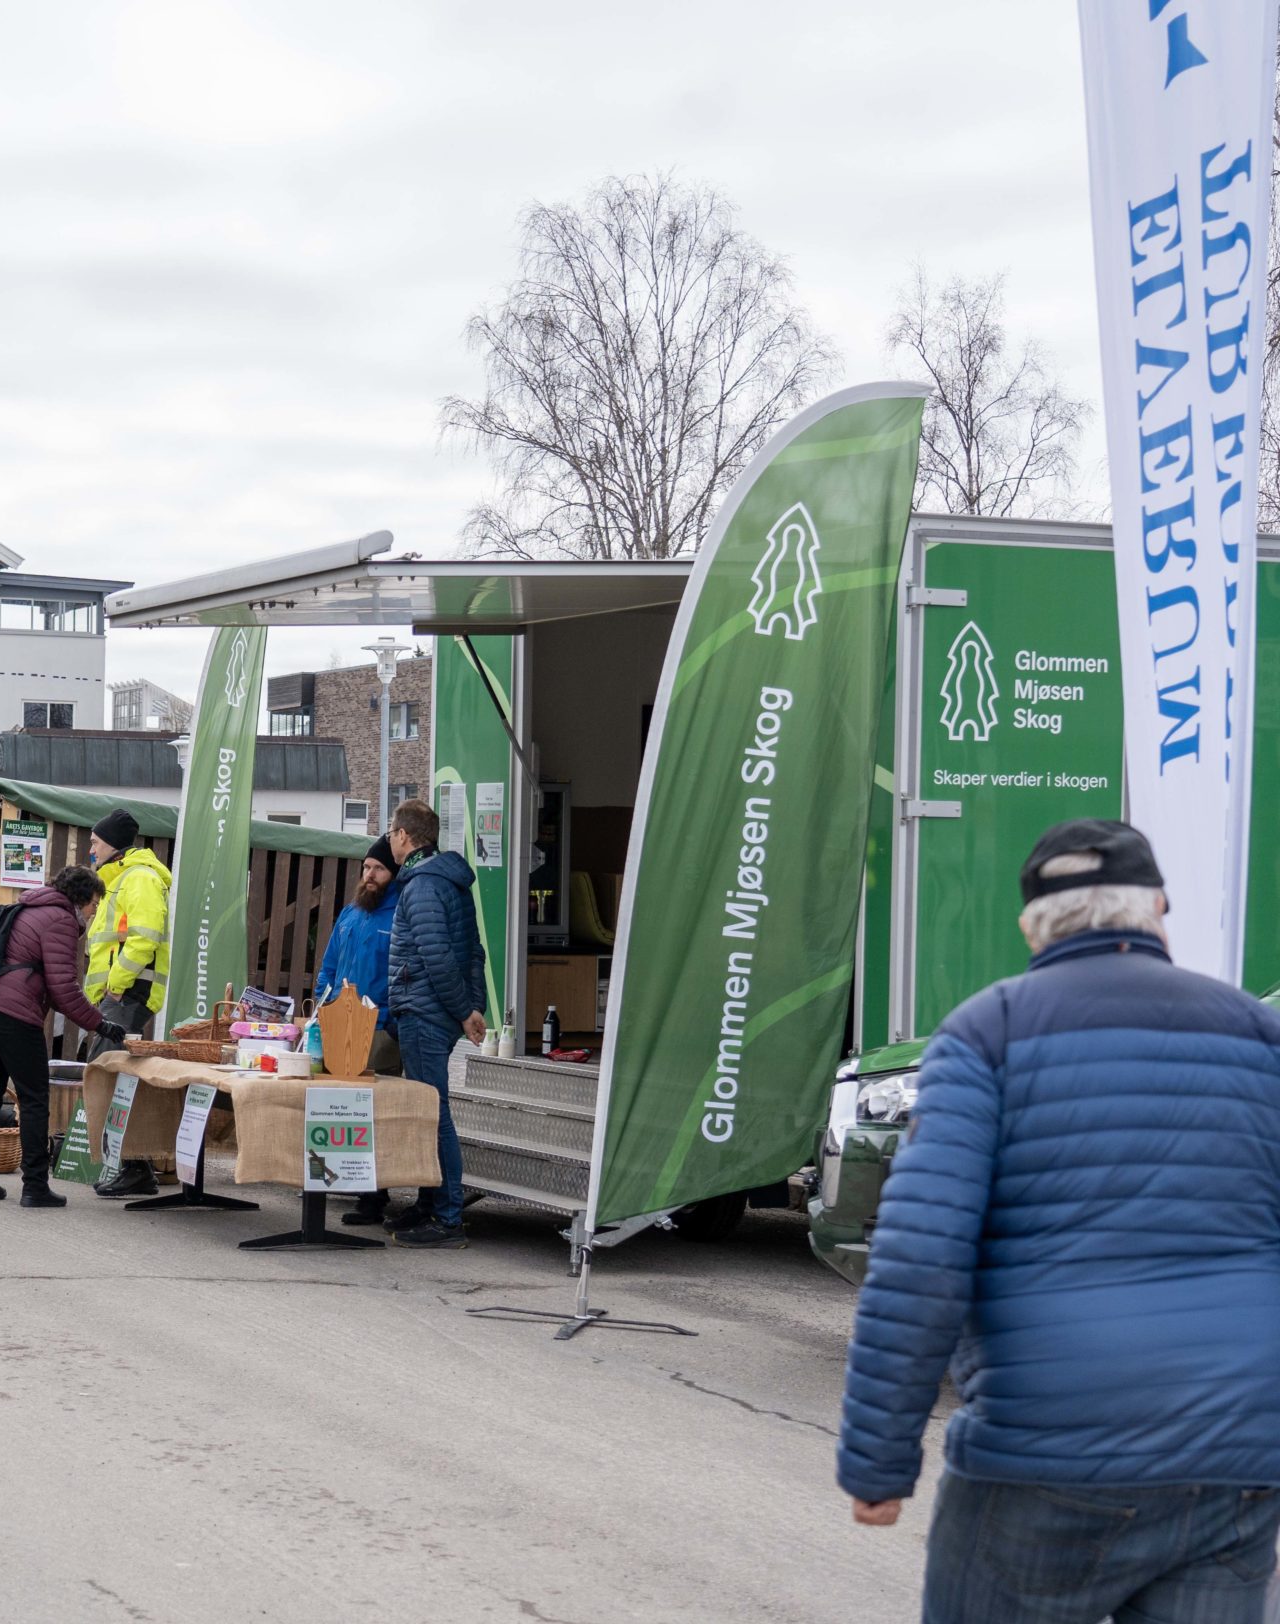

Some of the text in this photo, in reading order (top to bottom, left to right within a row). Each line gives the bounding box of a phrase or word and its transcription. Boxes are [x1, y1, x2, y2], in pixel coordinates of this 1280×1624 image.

[1015, 650, 1108, 673] Glommen
[1014, 679, 1083, 704] Mjøsen
[1013, 708, 1062, 734] Skog
[213, 747, 237, 811] Skog
[933, 769, 1108, 792] Skaper verdier i skogen
[5, 821, 44, 832] ÅRETS GAVEBOK
[477, 813, 502, 831] QUIZ
[701, 686, 793, 1144] Glommen Mjøsen Skog
[310, 1126, 368, 1147] QUIZ
